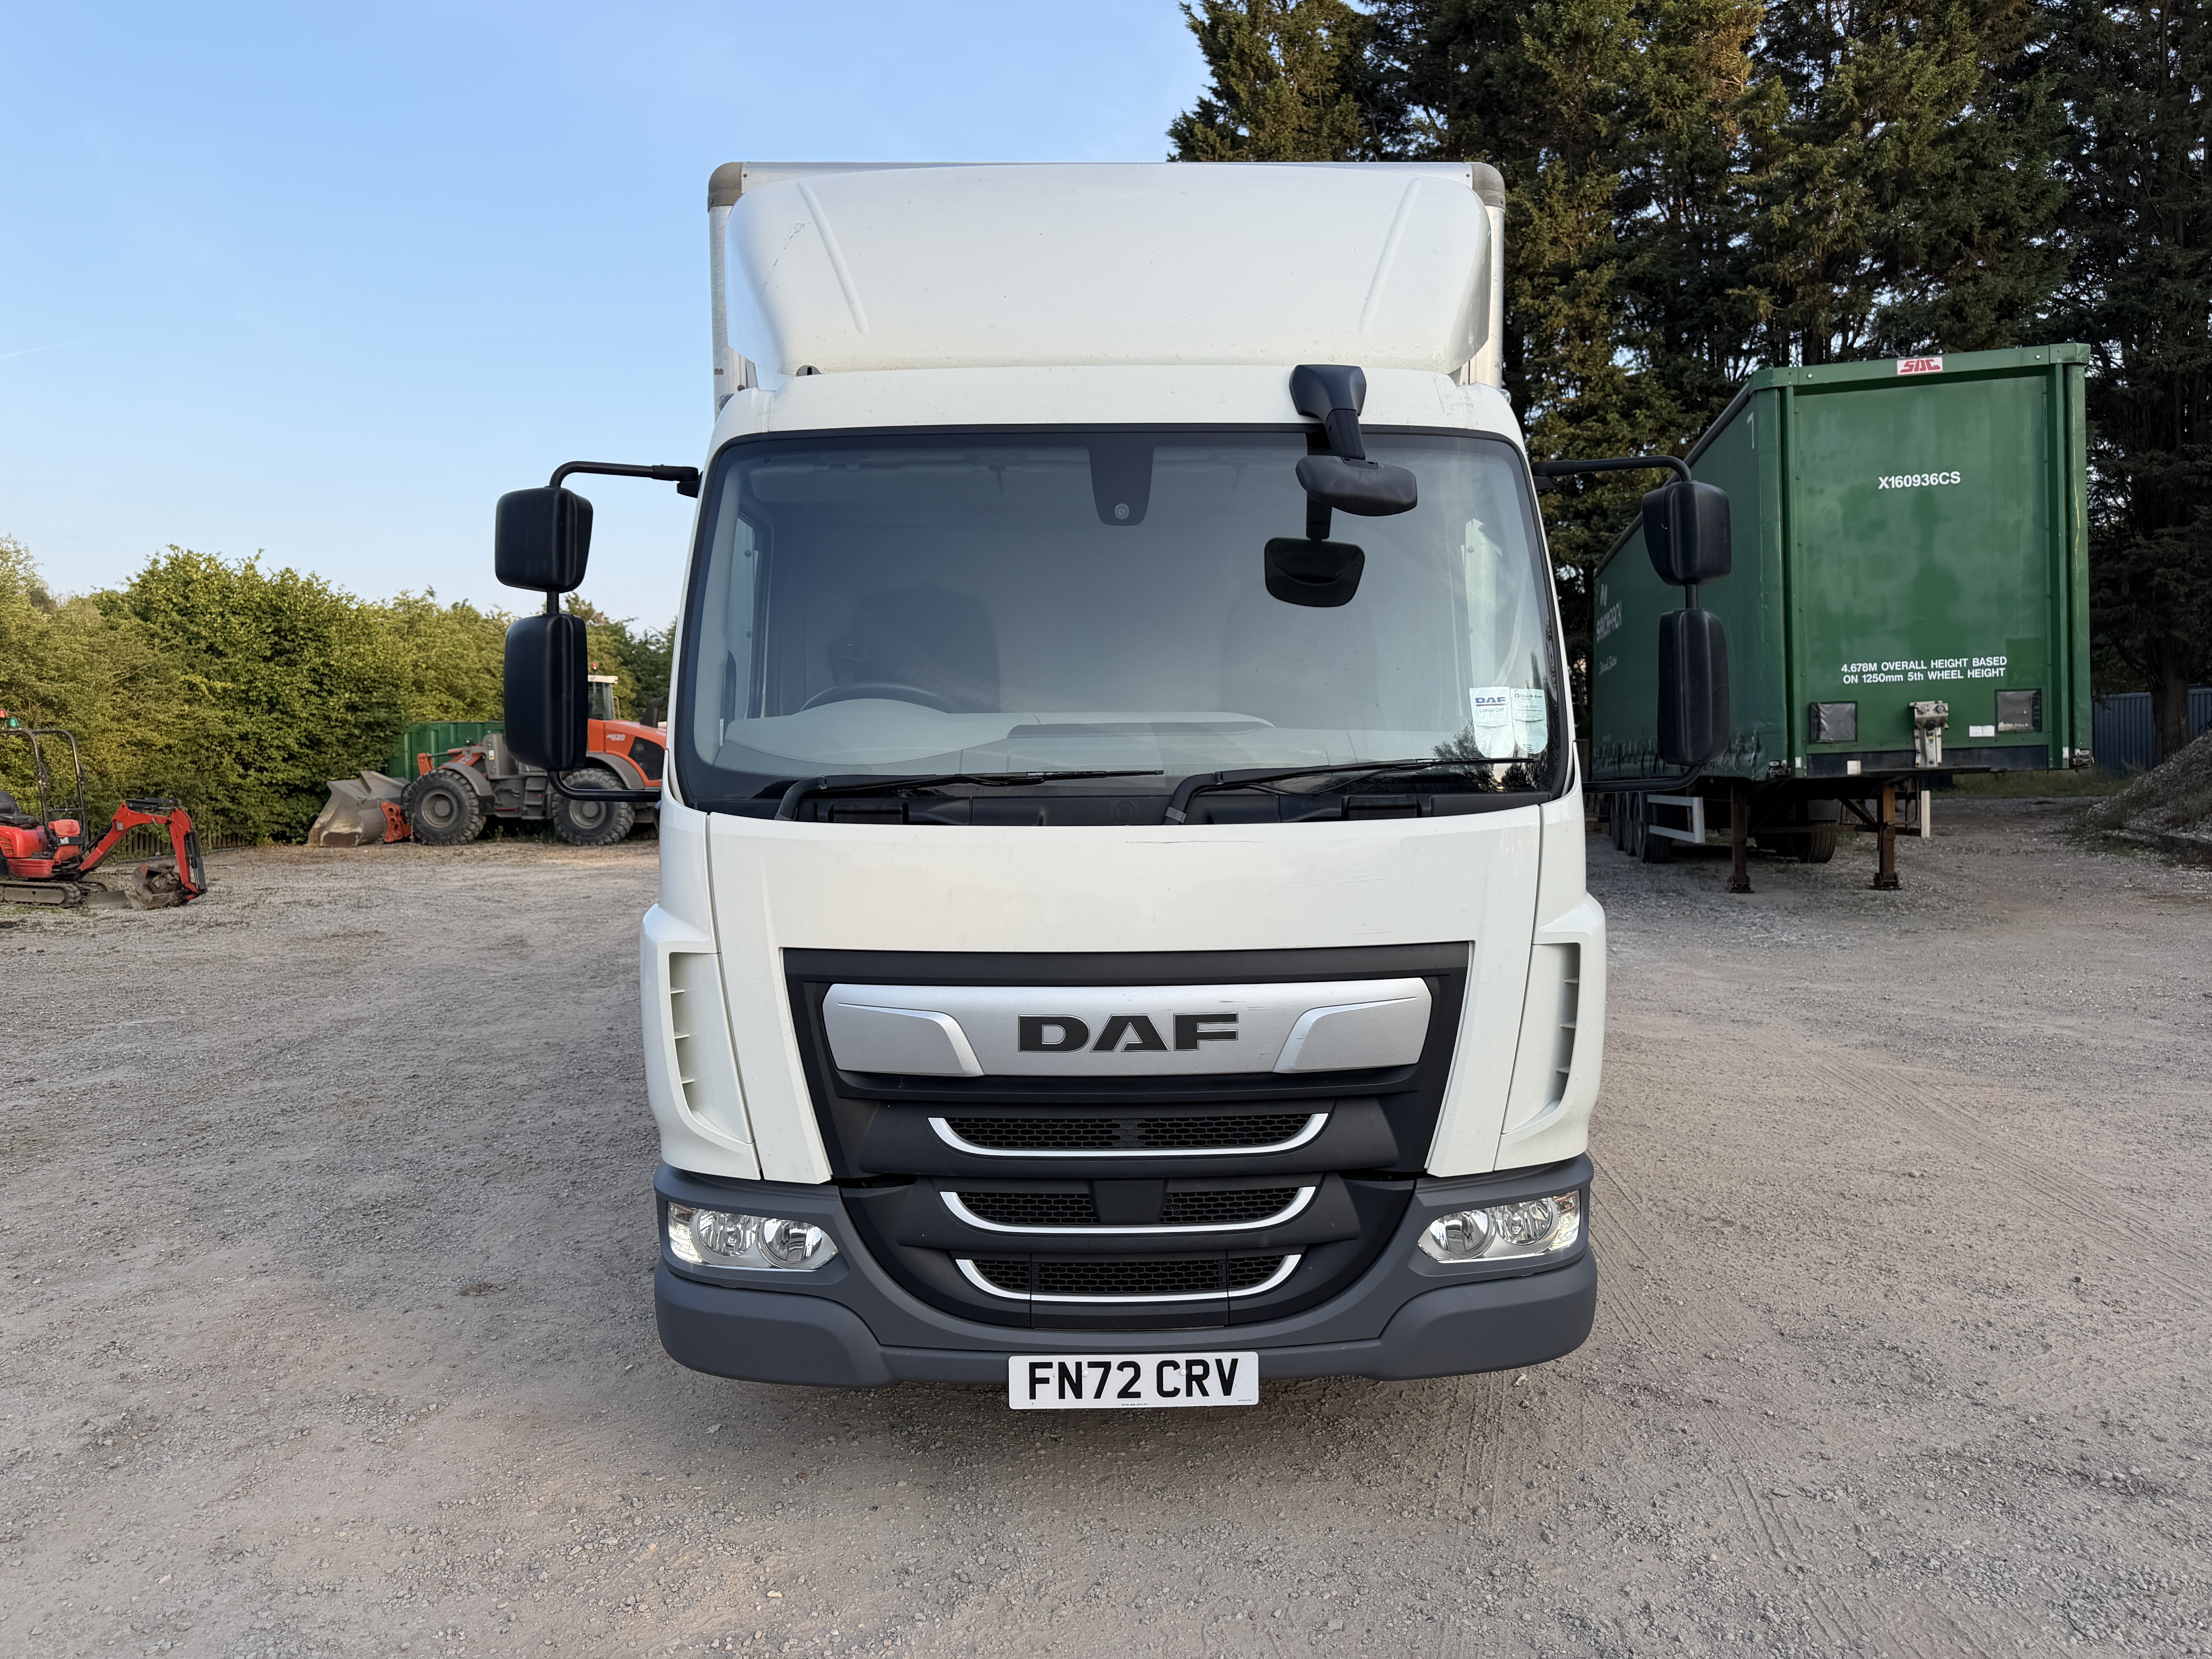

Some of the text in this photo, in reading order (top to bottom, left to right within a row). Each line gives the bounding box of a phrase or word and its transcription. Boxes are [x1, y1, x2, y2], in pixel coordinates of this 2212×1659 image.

[1899, 359, 1941, 373] SDC
[1878, 471, 1961, 489] X160936CS
[1841, 656, 2007, 673] 4.678M OVERALL HEIGHT BASED
[1843, 667, 2006, 684] ON 1250mm 5th WHEEL HEIGHT
[1018, 1012, 1238, 1053] DAF
[1029, 1358, 1239, 1400] FN72 CRV
